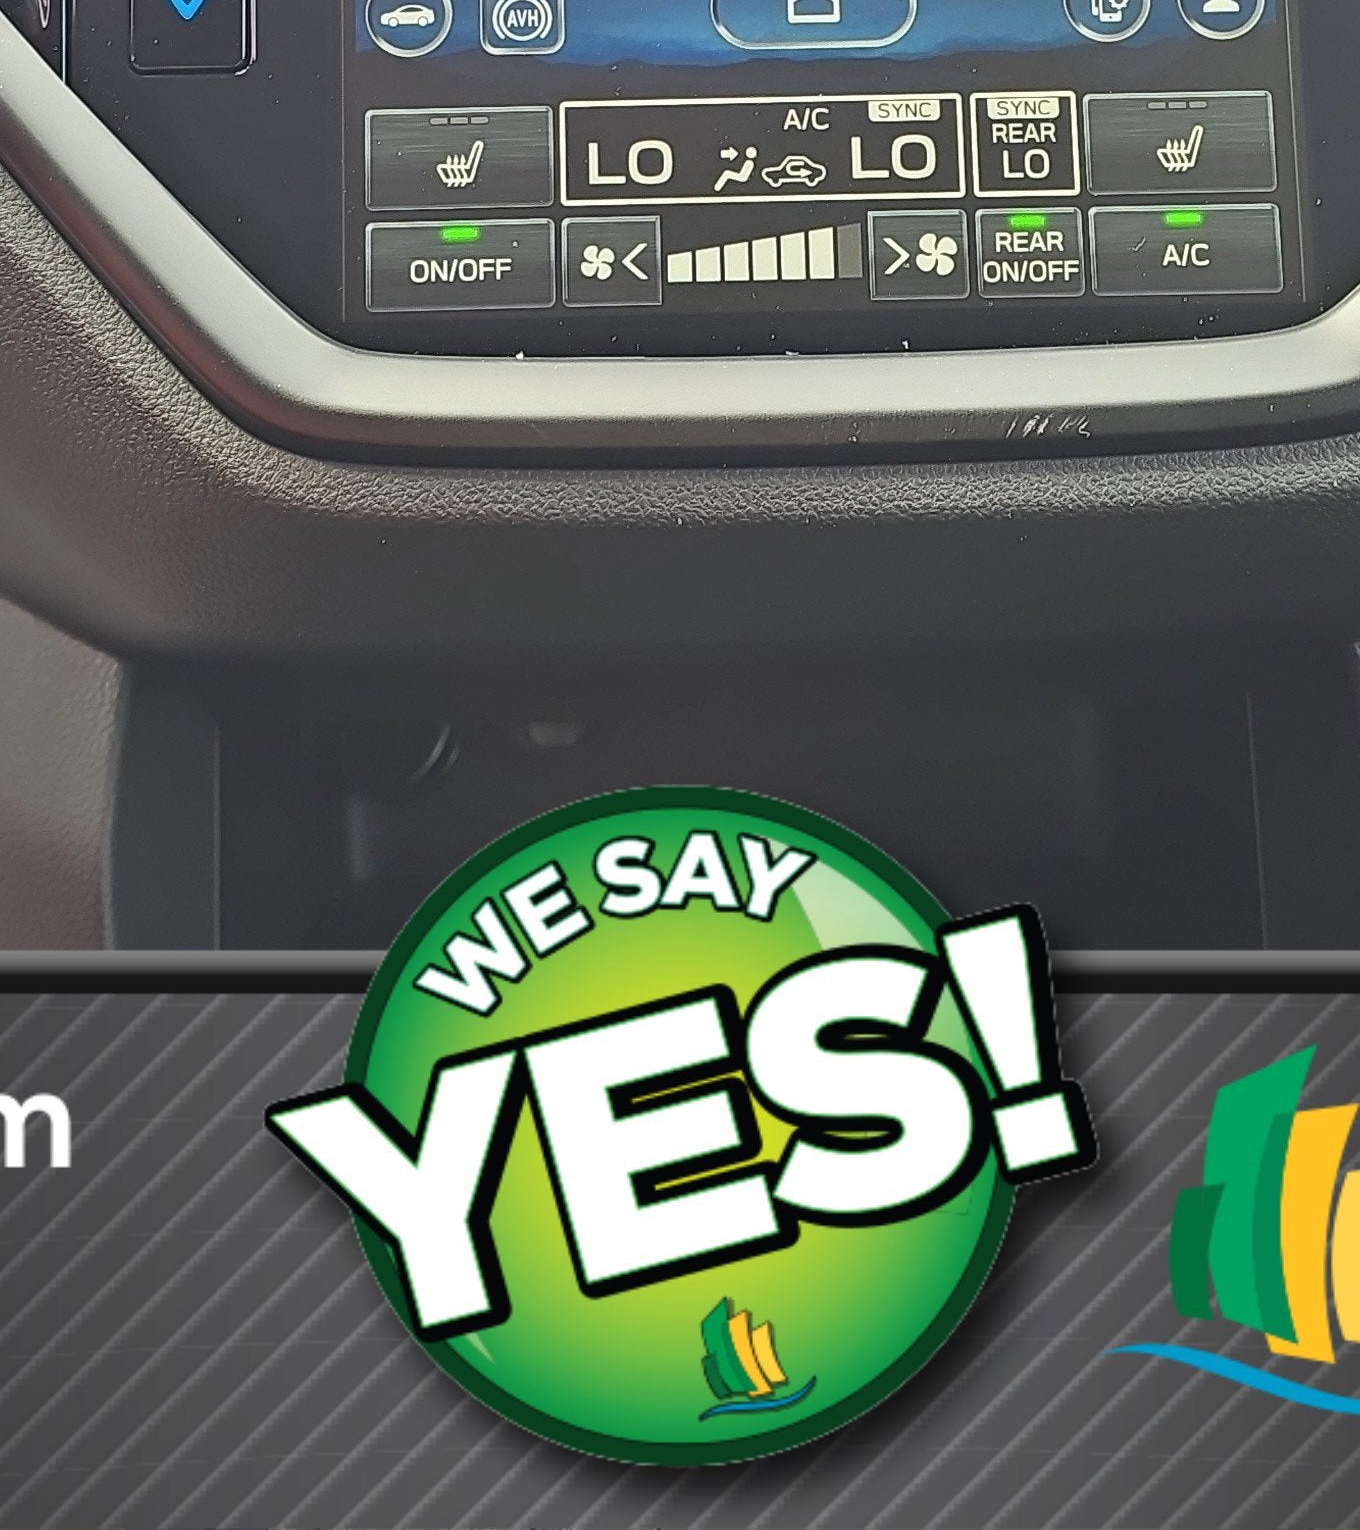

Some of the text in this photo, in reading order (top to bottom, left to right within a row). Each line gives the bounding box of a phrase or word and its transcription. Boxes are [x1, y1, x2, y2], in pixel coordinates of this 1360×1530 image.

[506, 8, 540, 29] AVH
[783, 107, 830, 132] A/C
[877, 100, 933, 119] SYNC
[995, 98, 1052, 118] SYNC
[991, 122, 1056, 145] REAR
[588, 140, 674, 186] LO
[850, 133, 938, 181] LO
[1002, 150, 1051, 181] LO
[995, 231, 1064, 253] REAR
[1163, 244, 1210, 268] A/C
[409, 257, 512, 284] ON/OFF
[983, 257, 1080, 284] ON/OFF
